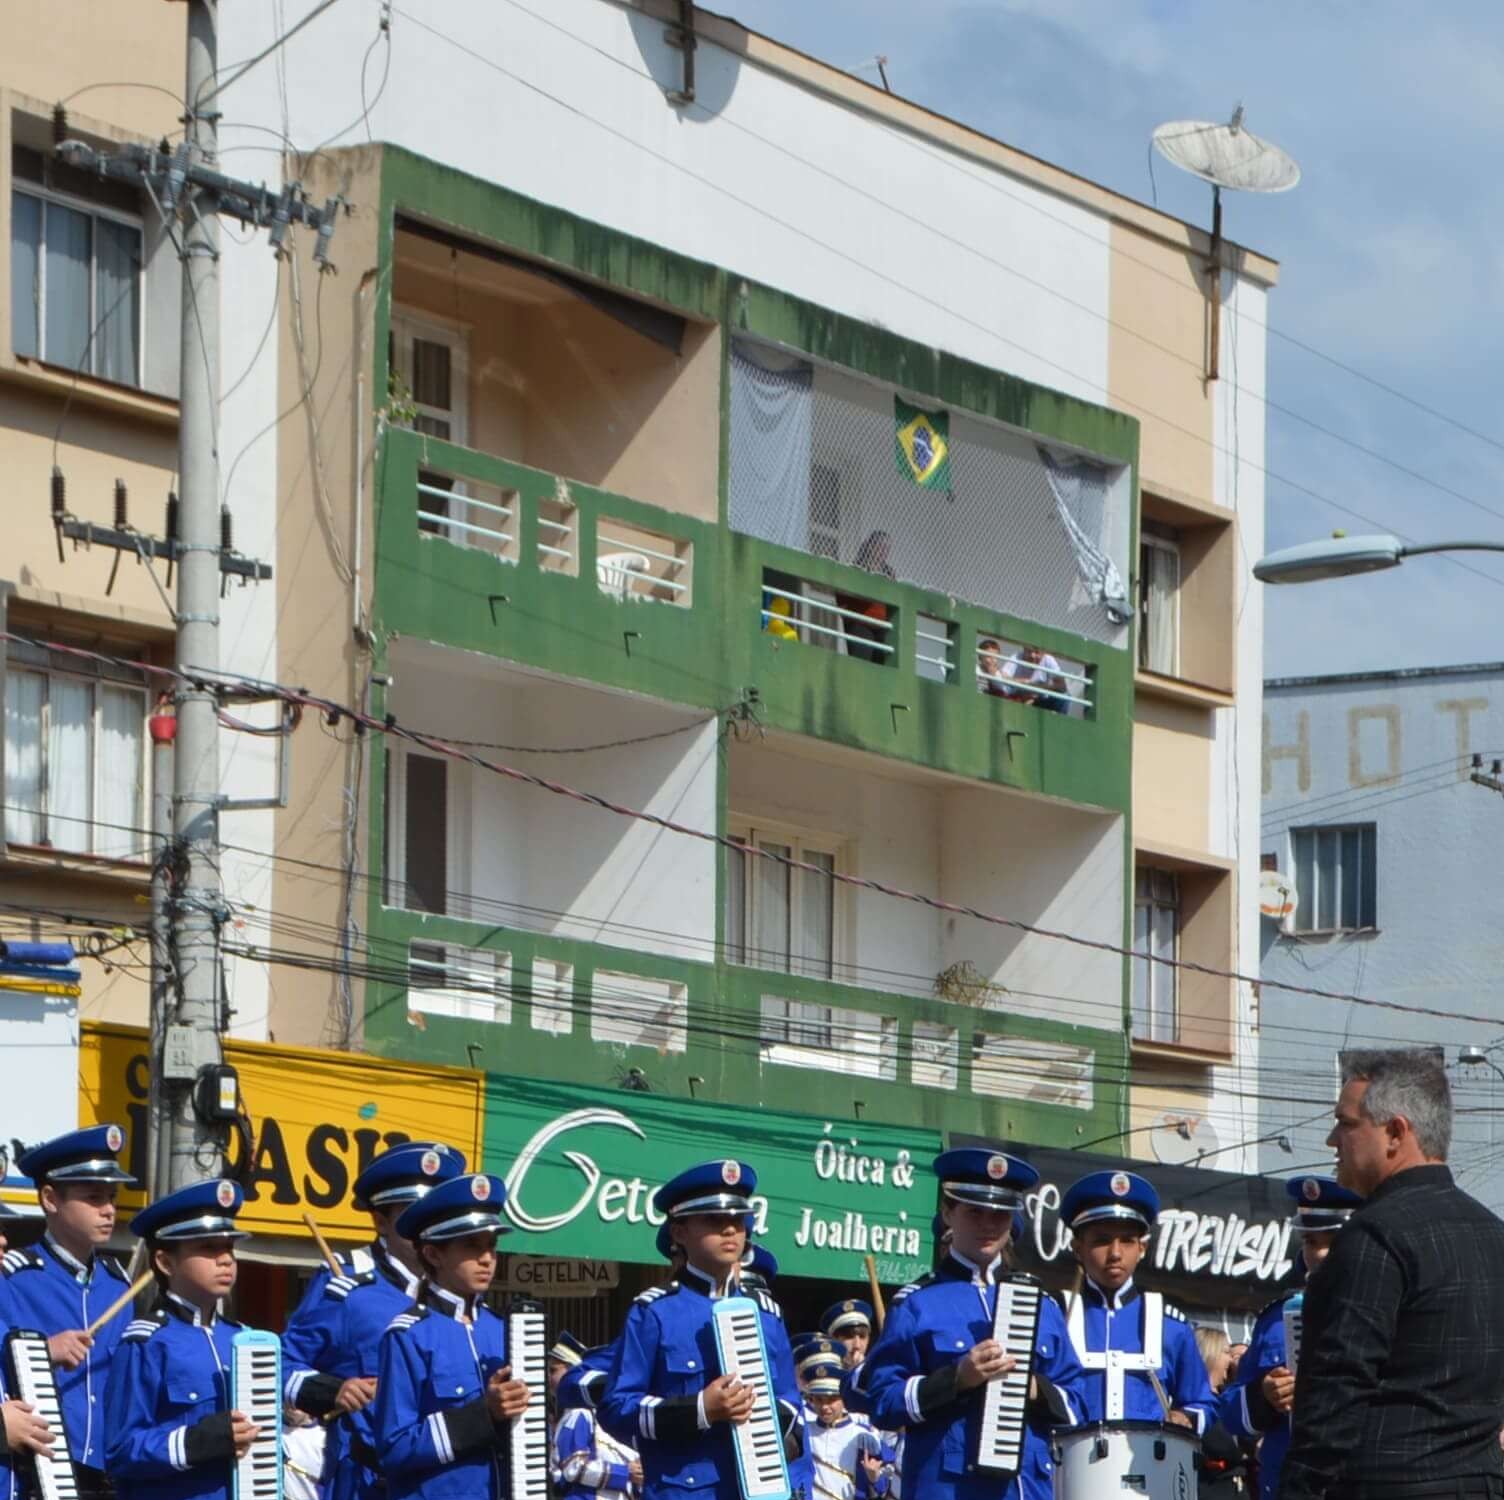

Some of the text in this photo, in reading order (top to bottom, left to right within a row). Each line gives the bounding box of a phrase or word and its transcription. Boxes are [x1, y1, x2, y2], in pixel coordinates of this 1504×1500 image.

[814, 1122, 915, 1189] Ótica &
[794, 1206, 920, 1257] Joalheria
[1154, 1208, 1293, 1282] TREVISOL
[515, 1260, 611, 1283] GETELINA
